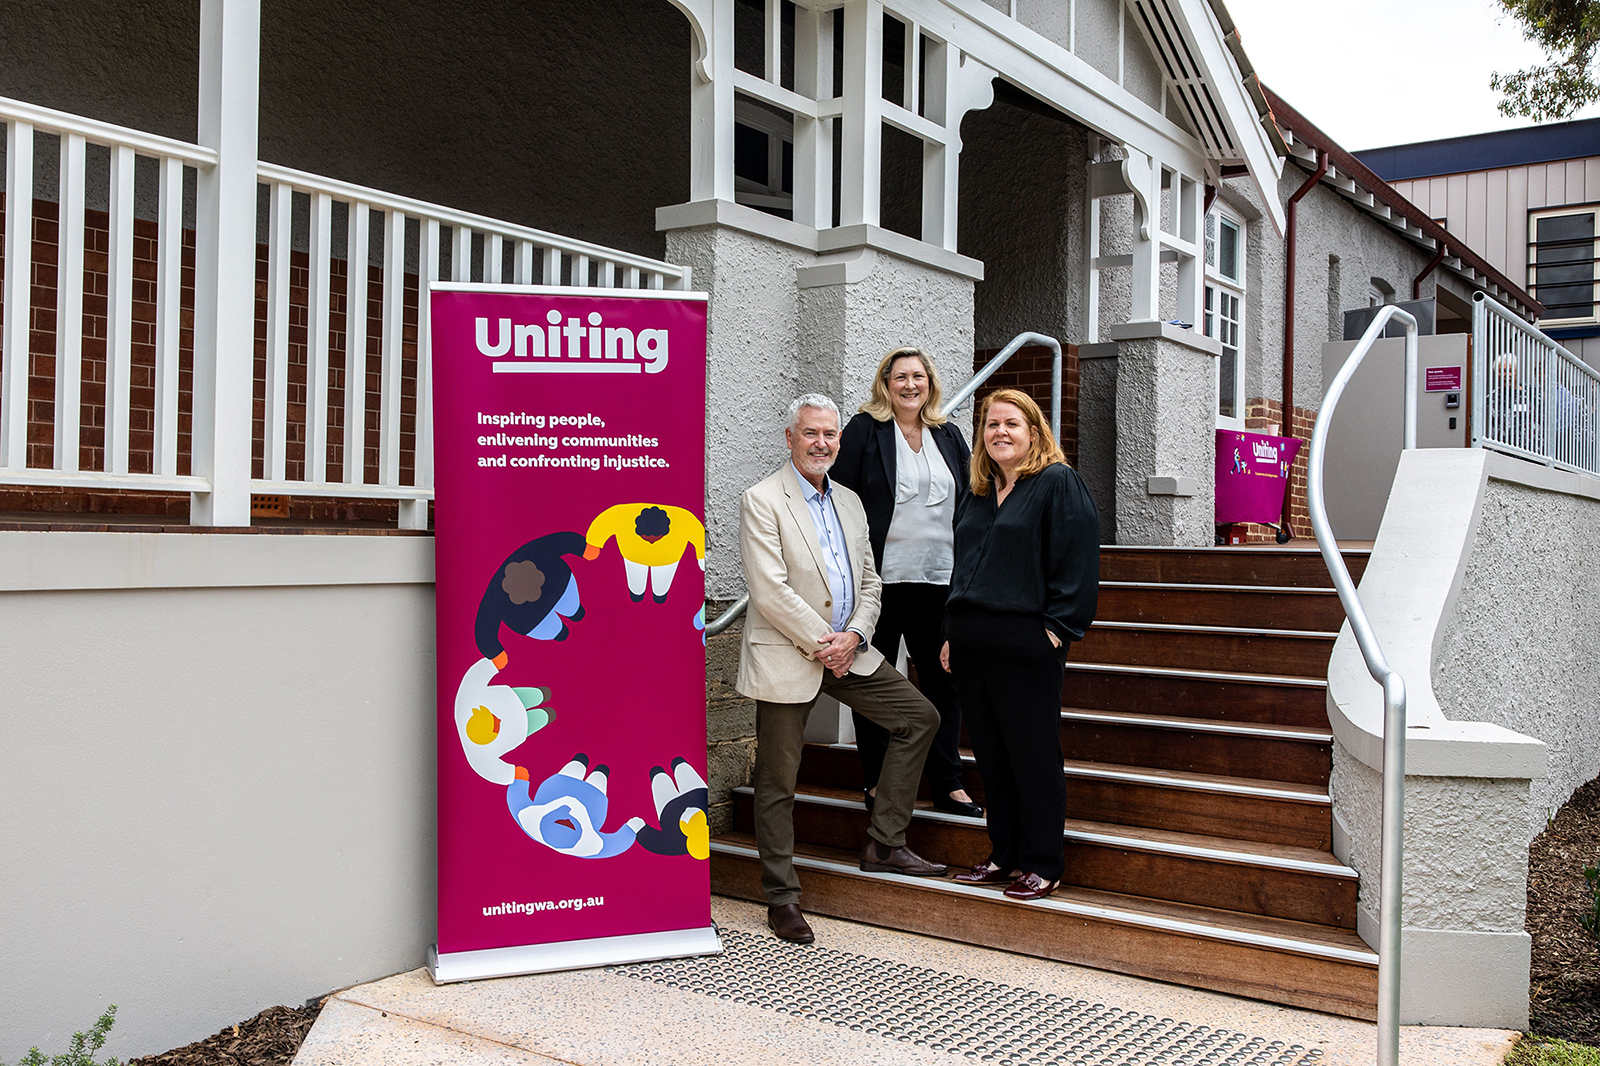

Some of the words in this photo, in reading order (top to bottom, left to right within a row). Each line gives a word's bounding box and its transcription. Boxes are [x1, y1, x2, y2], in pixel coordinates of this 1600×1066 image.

[475, 310, 668, 373] Uniting
[477, 411, 545, 429] Inspiring
[549, 412, 606, 429] people,
[477, 432, 558, 450] enlivening
[561, 433, 659, 448] communities
[1252, 439, 1278, 464] Uniting
[477, 454, 507, 468] and
[510, 454, 601, 471] confronting
[603, 454, 670, 471] injustice.
[482, 896, 604, 917] unitingwa.org.au
